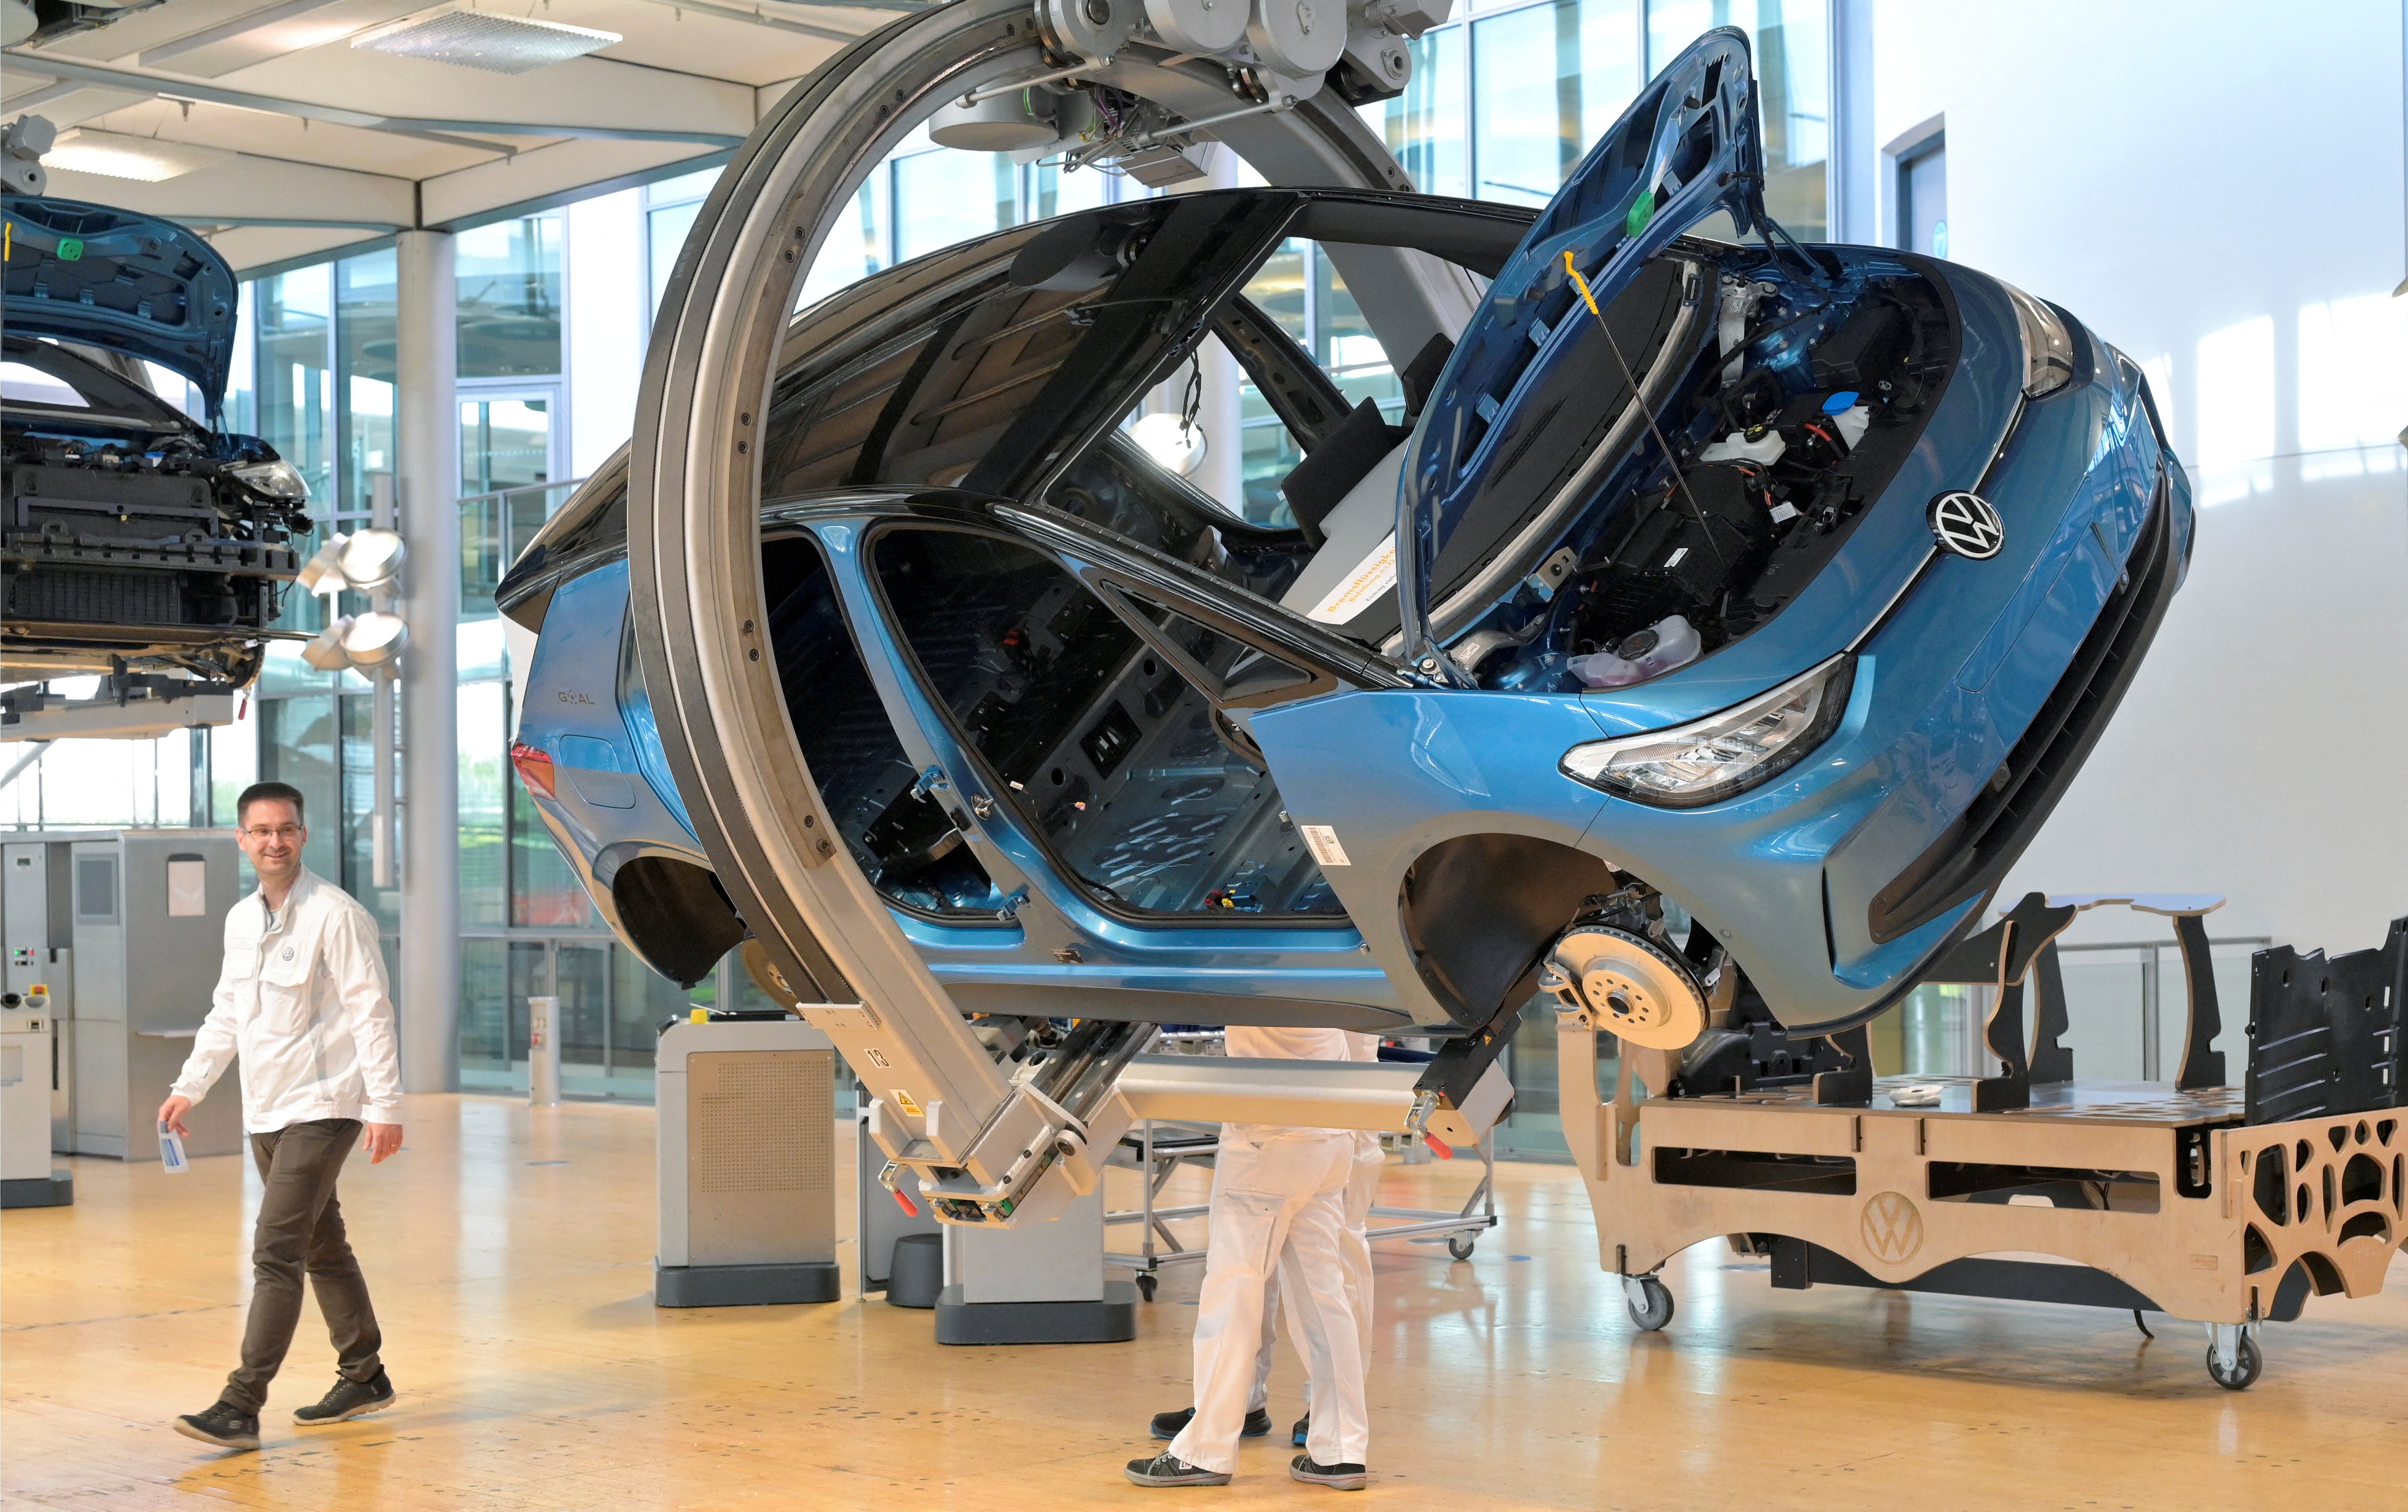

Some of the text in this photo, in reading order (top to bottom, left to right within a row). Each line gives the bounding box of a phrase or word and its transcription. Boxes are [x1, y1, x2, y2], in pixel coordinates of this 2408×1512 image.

[1937, 494, 2002, 556] VW
[1327, 546, 1395, 612] Bremsflüssigke
[1366, 574, 1396, 601] Eintrag sieh
[867, 1049, 890, 1067] 13
[1862, 1192, 1923, 1264] VW
